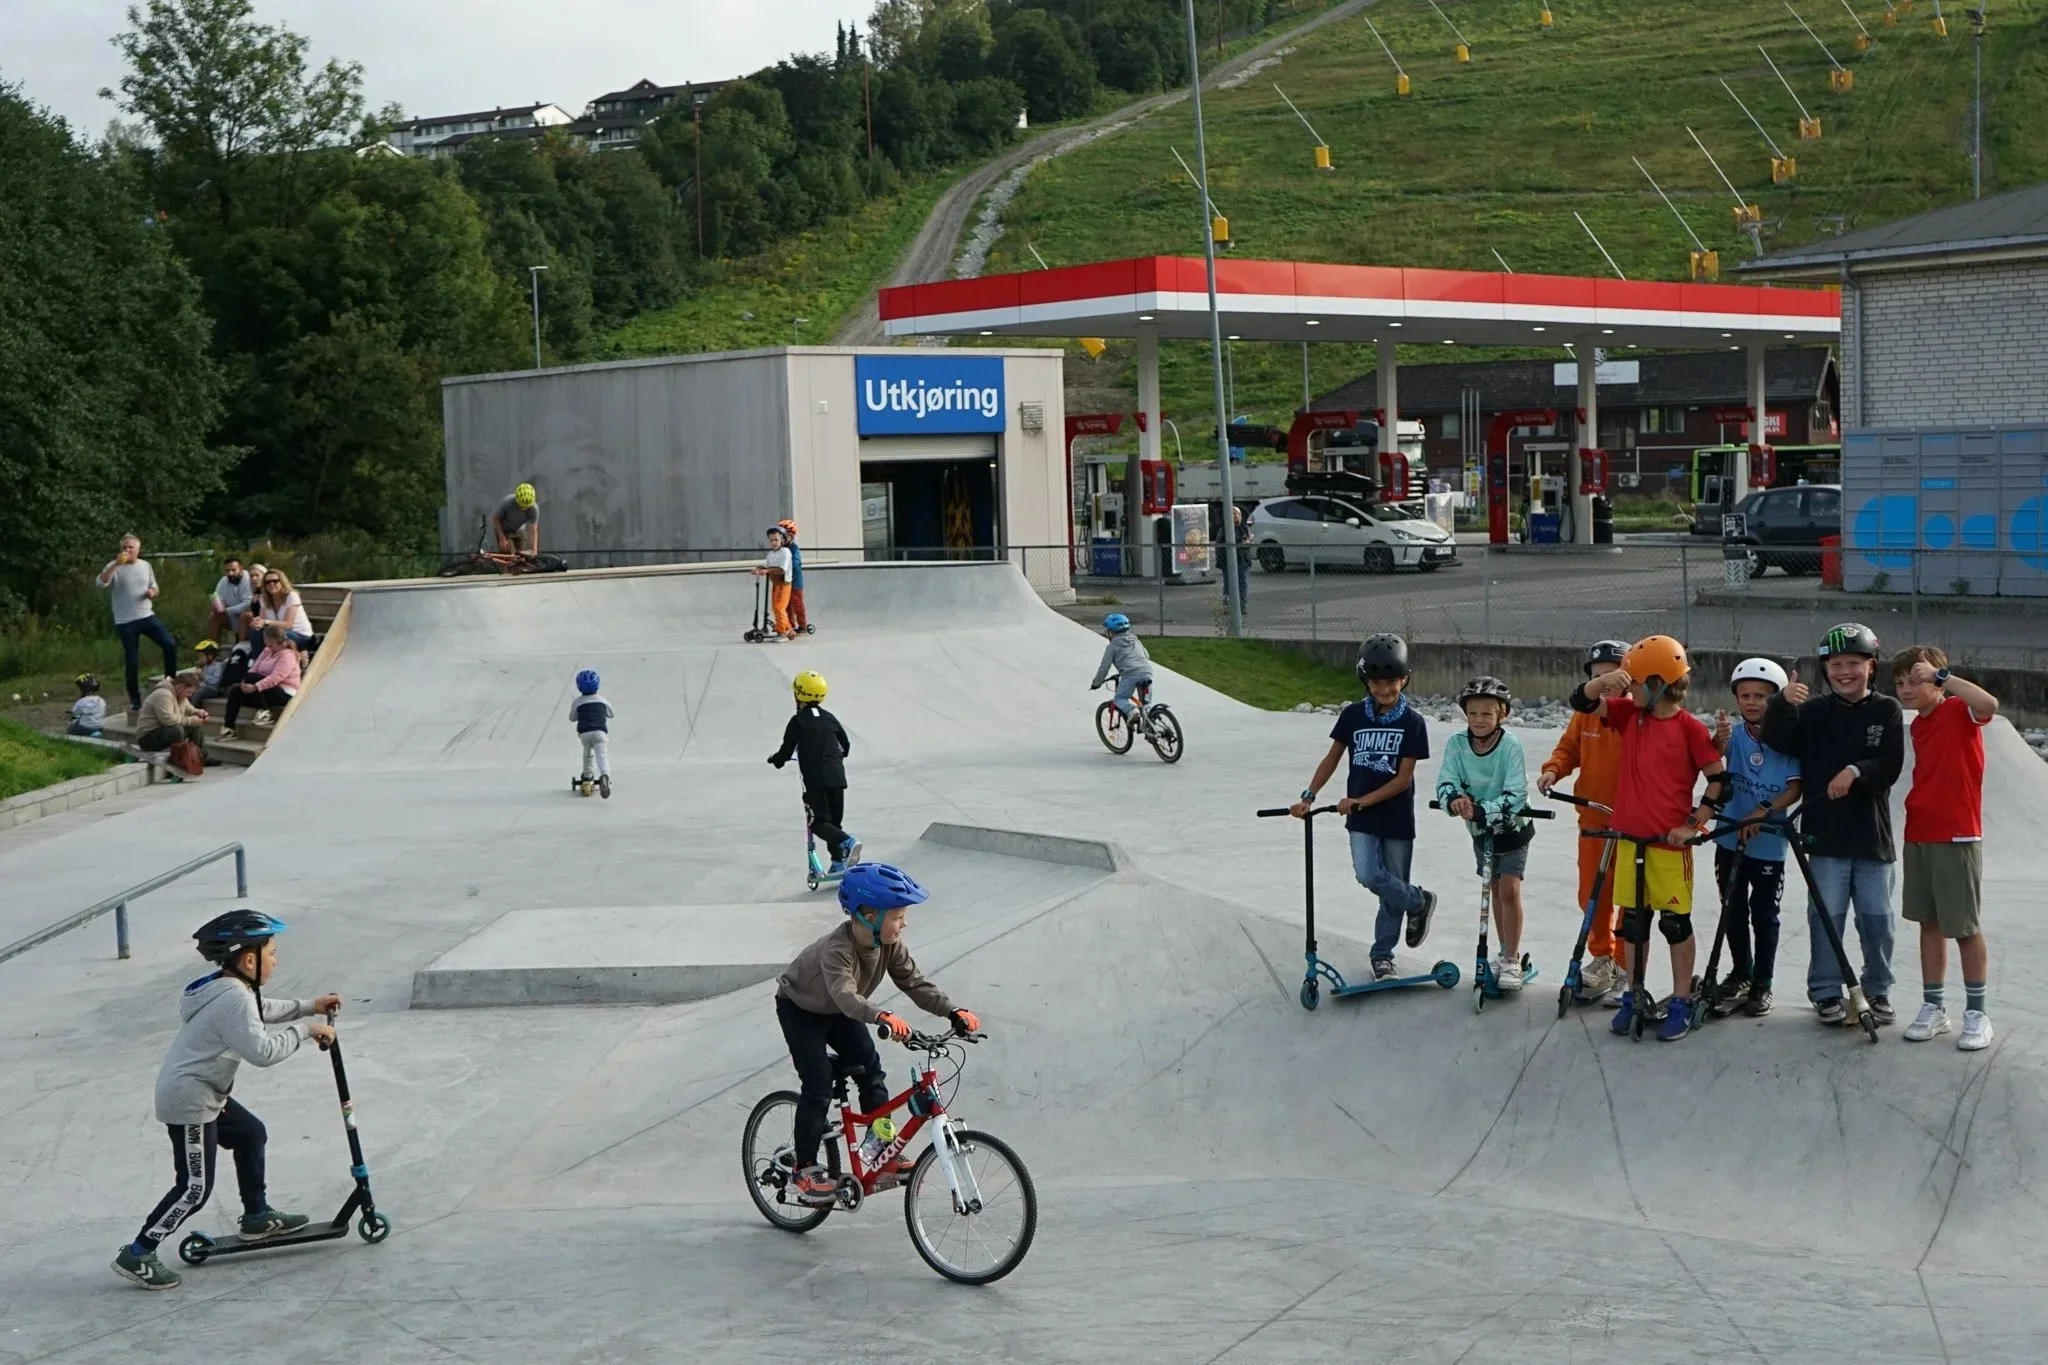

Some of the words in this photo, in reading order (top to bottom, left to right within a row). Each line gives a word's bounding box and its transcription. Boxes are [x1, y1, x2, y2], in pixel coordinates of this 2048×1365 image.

[865, 379, 998, 418] Utkjøring
[1353, 731, 1403, 754] SUMMER
[188, 1123, 201, 1144] MARV
[871, 1136, 906, 1172] woom
[161, 1207, 186, 1231] MARVEL
